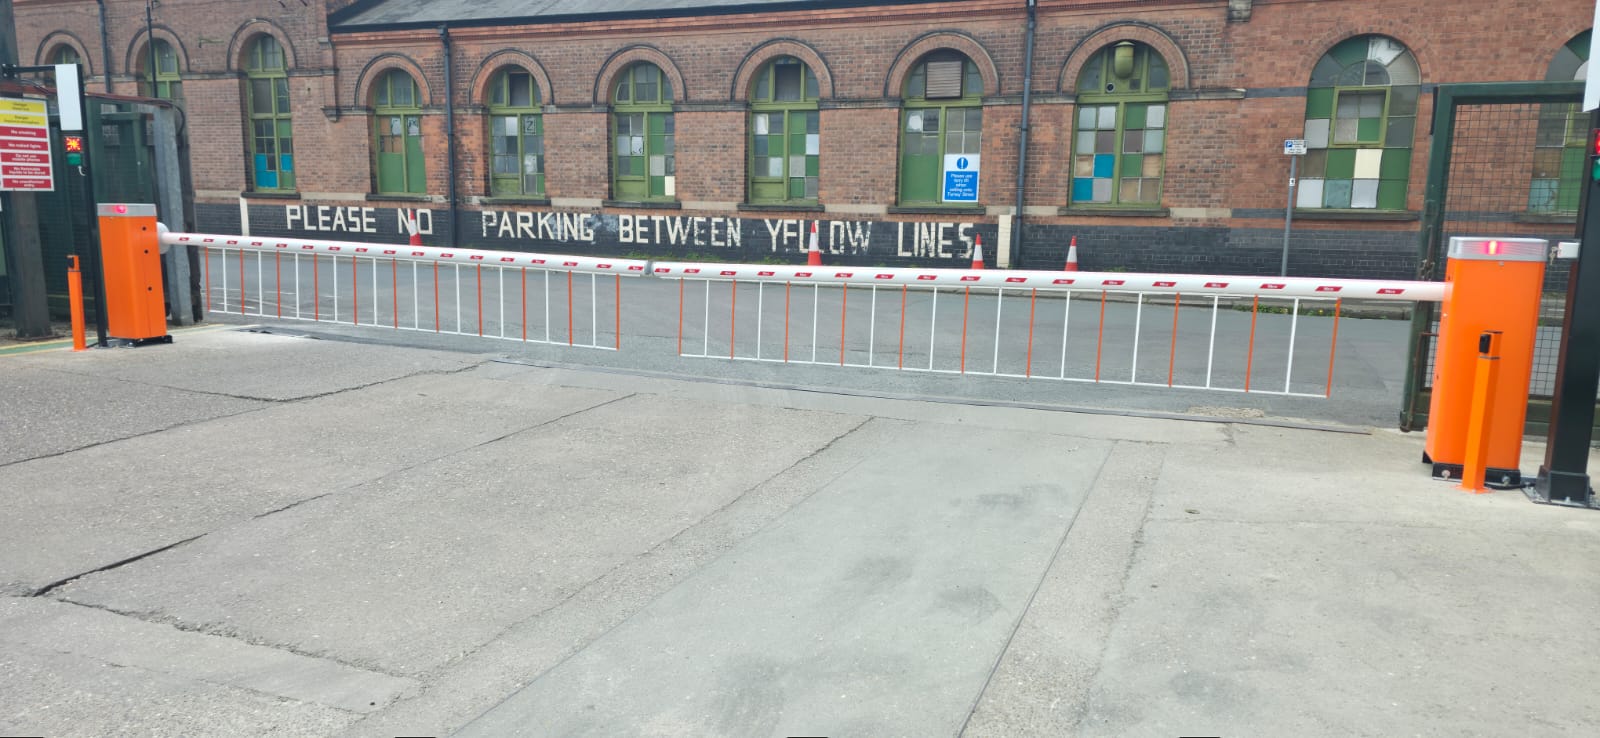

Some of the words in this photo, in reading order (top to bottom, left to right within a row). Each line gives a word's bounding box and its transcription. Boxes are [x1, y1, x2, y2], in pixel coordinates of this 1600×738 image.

[286, 204, 376, 232] PLEASE
[398, 208, 432, 234] NO
[482, 211, 594, 241] PARKING
[618, 214, 741, 247] BETWEEN
[764, 220, 872, 255] YELLOW
[898, 222, 974, 258] LINES
